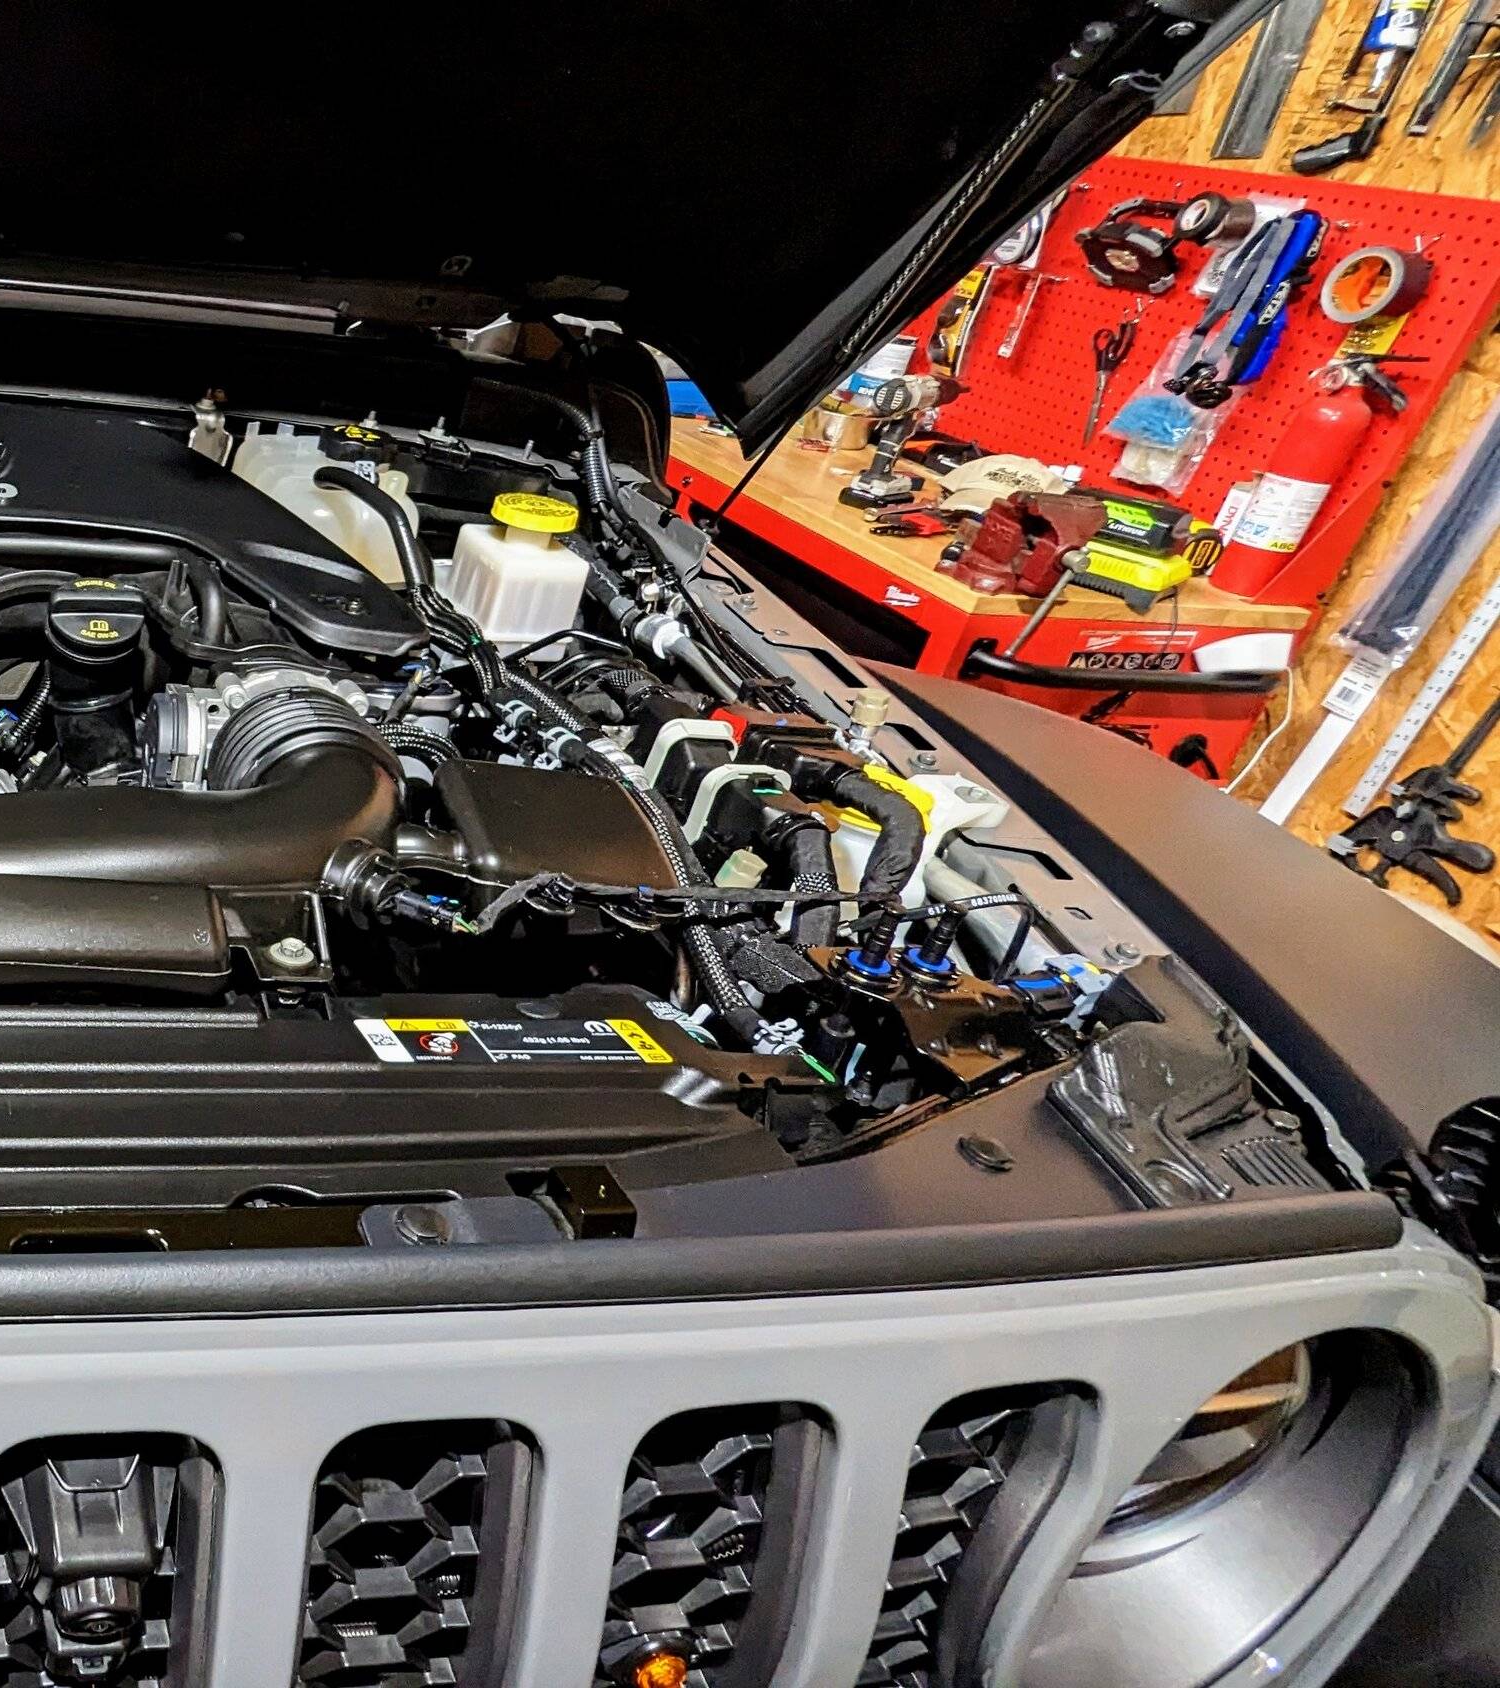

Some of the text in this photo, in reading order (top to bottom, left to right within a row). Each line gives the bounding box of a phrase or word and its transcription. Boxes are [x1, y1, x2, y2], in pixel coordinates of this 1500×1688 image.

[1270, 541, 1296, 551] ABC
[74, 580, 117, 590] ENGINE OIL
